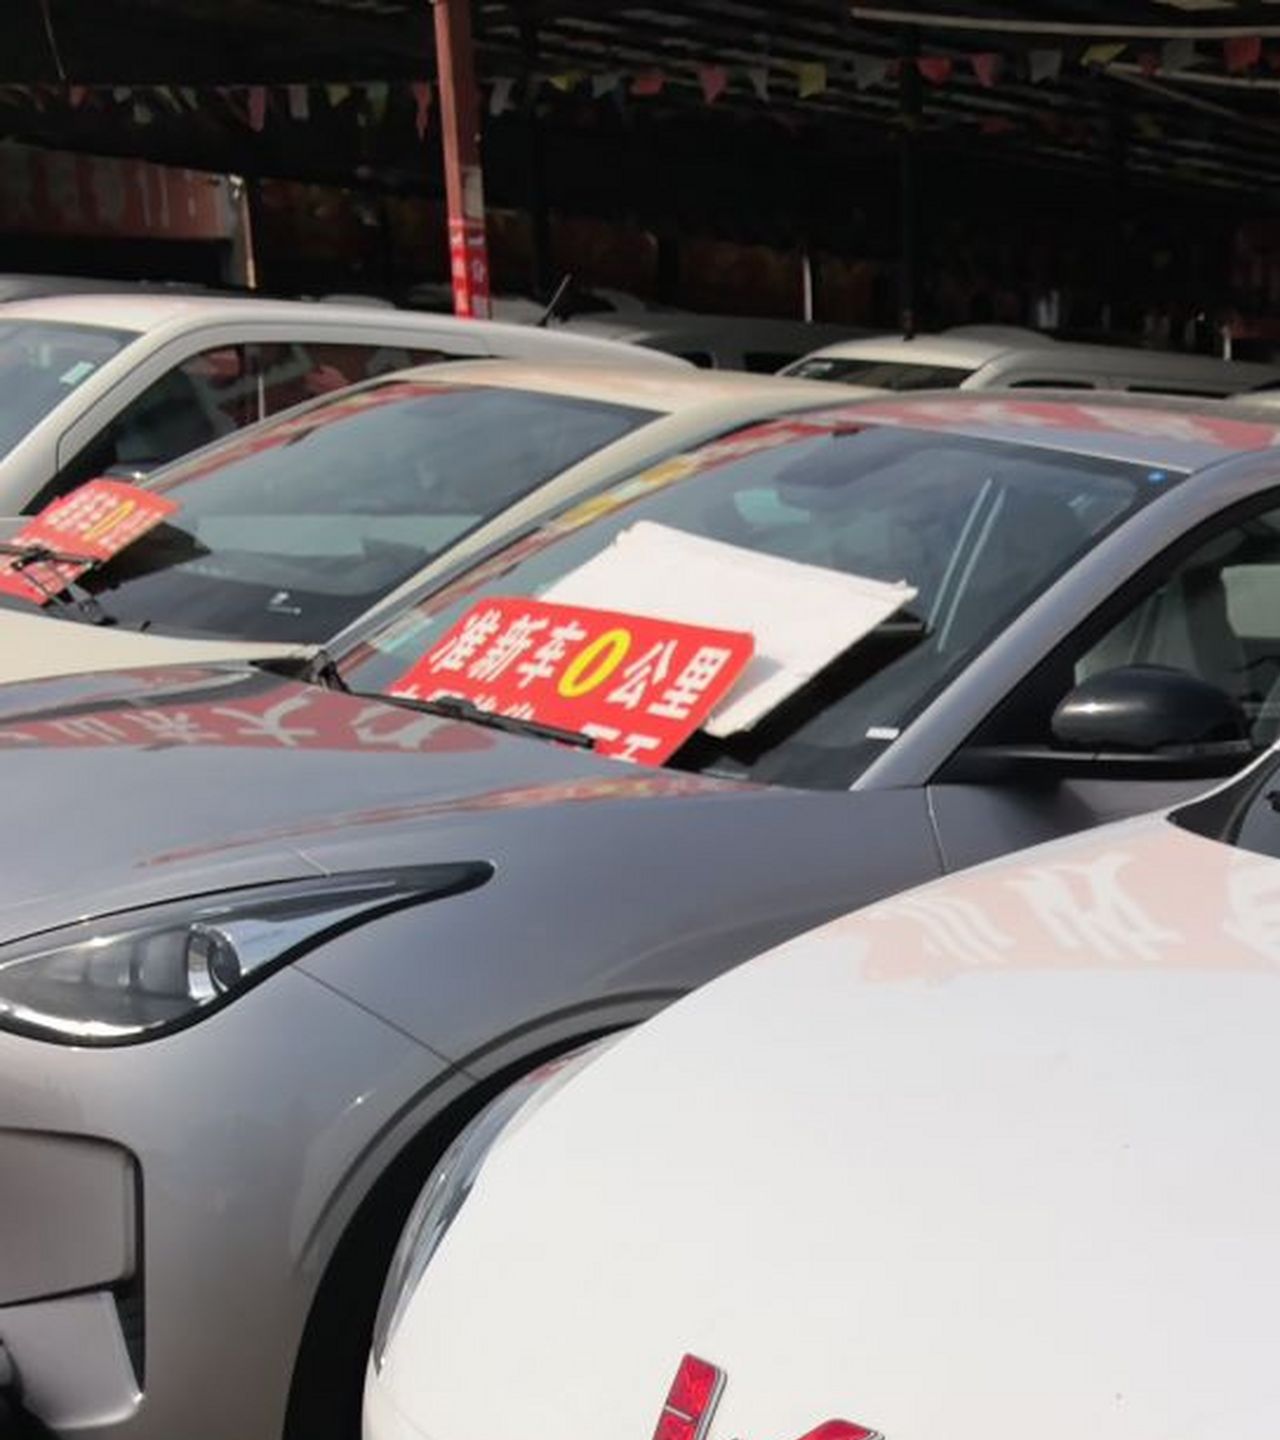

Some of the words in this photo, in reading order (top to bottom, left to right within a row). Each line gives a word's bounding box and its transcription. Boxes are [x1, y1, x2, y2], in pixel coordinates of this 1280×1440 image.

[429, 608, 733, 720] 准新车0公里
